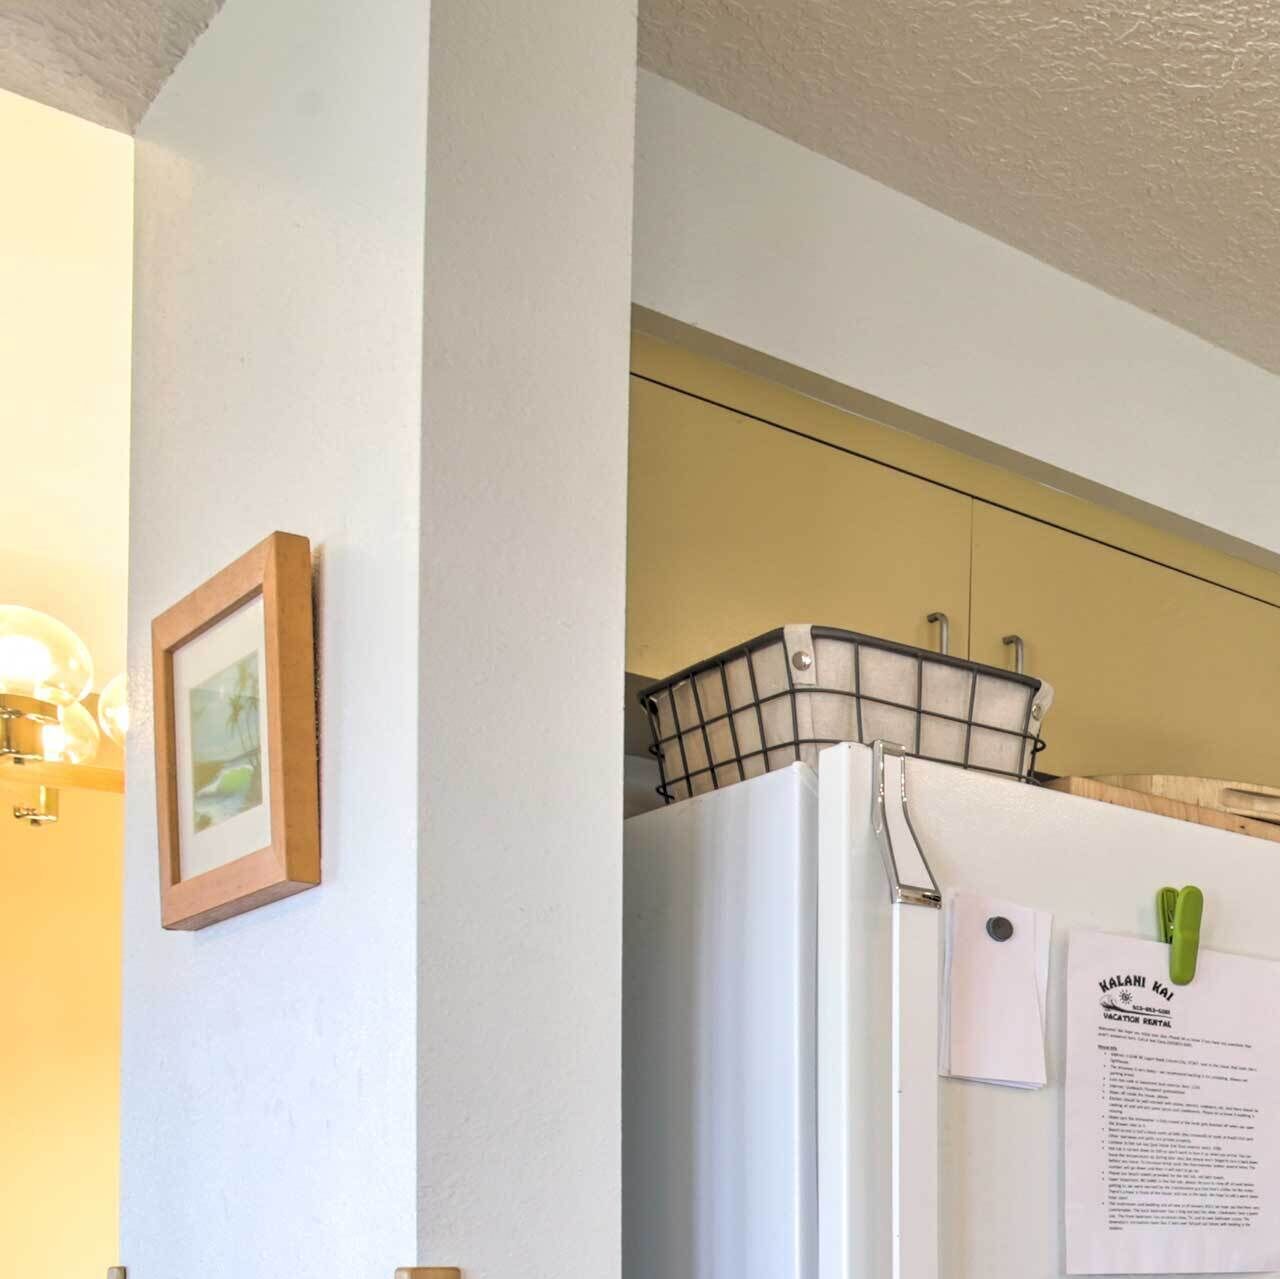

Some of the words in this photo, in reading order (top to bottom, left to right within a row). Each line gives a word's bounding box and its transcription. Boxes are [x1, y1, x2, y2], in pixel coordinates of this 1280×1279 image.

[1099, 975, 1146, 993] KALANI
[1152, 981, 1175, 1002] KAI
[1103, 1012, 1140, 1024] VACATION
[1143, 1017, 1172, 1029] RENTAL
